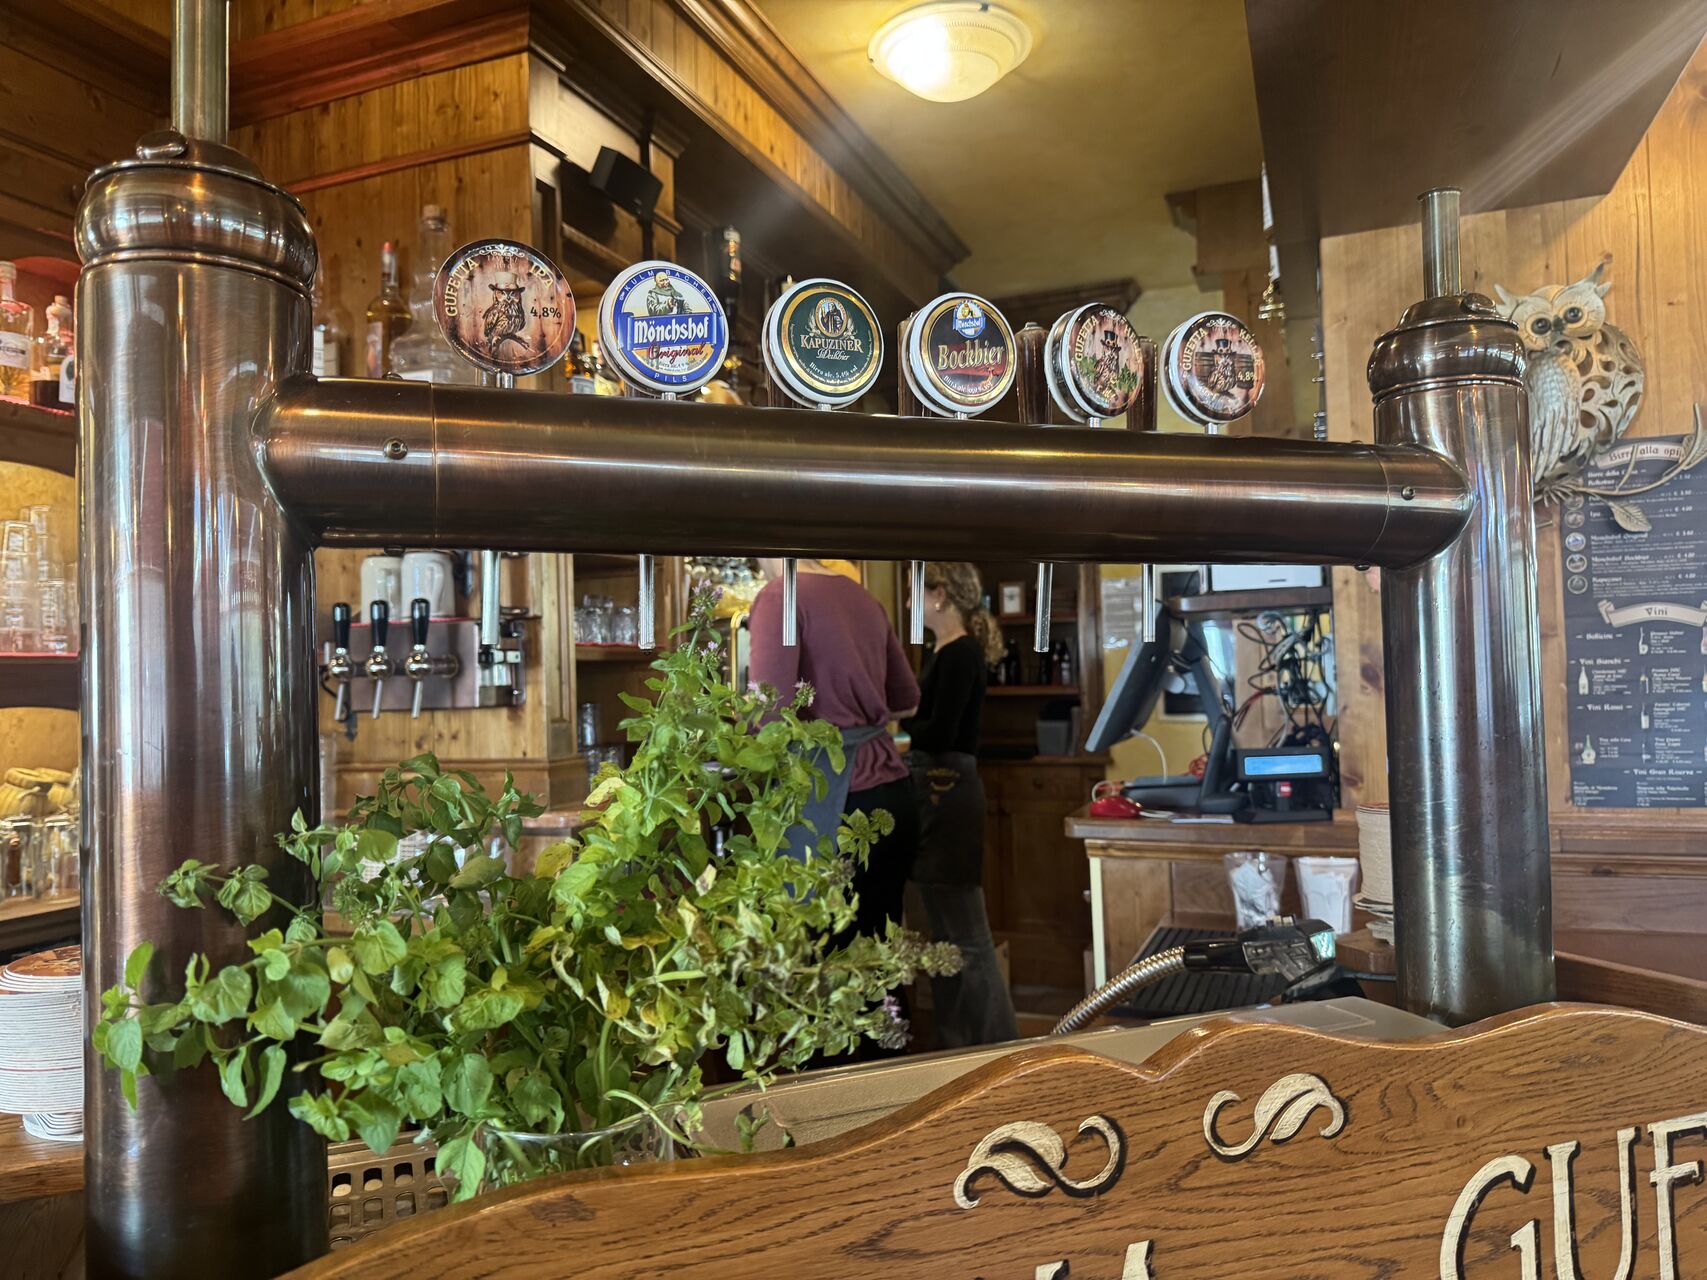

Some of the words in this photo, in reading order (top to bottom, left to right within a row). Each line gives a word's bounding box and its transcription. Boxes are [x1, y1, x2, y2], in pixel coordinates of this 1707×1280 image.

[444, 256, 479, 317] GUFETTA
[529, 261, 554, 289] IPA
[530, 306, 562, 318] 4,8%
[634, 316, 709, 343] Mönchshof
[1075, 315, 1099, 361] GUFETTA
[800, 334, 864, 353] KAPUZINER
[937, 339, 1005, 370] Bockbier
[1182, 327, 1208, 371] GUFETTA
[654, 373, 688, 382] PILS
[1639, 446, 1659, 455] alla
[1645, 607, 1668, 616] Vini
